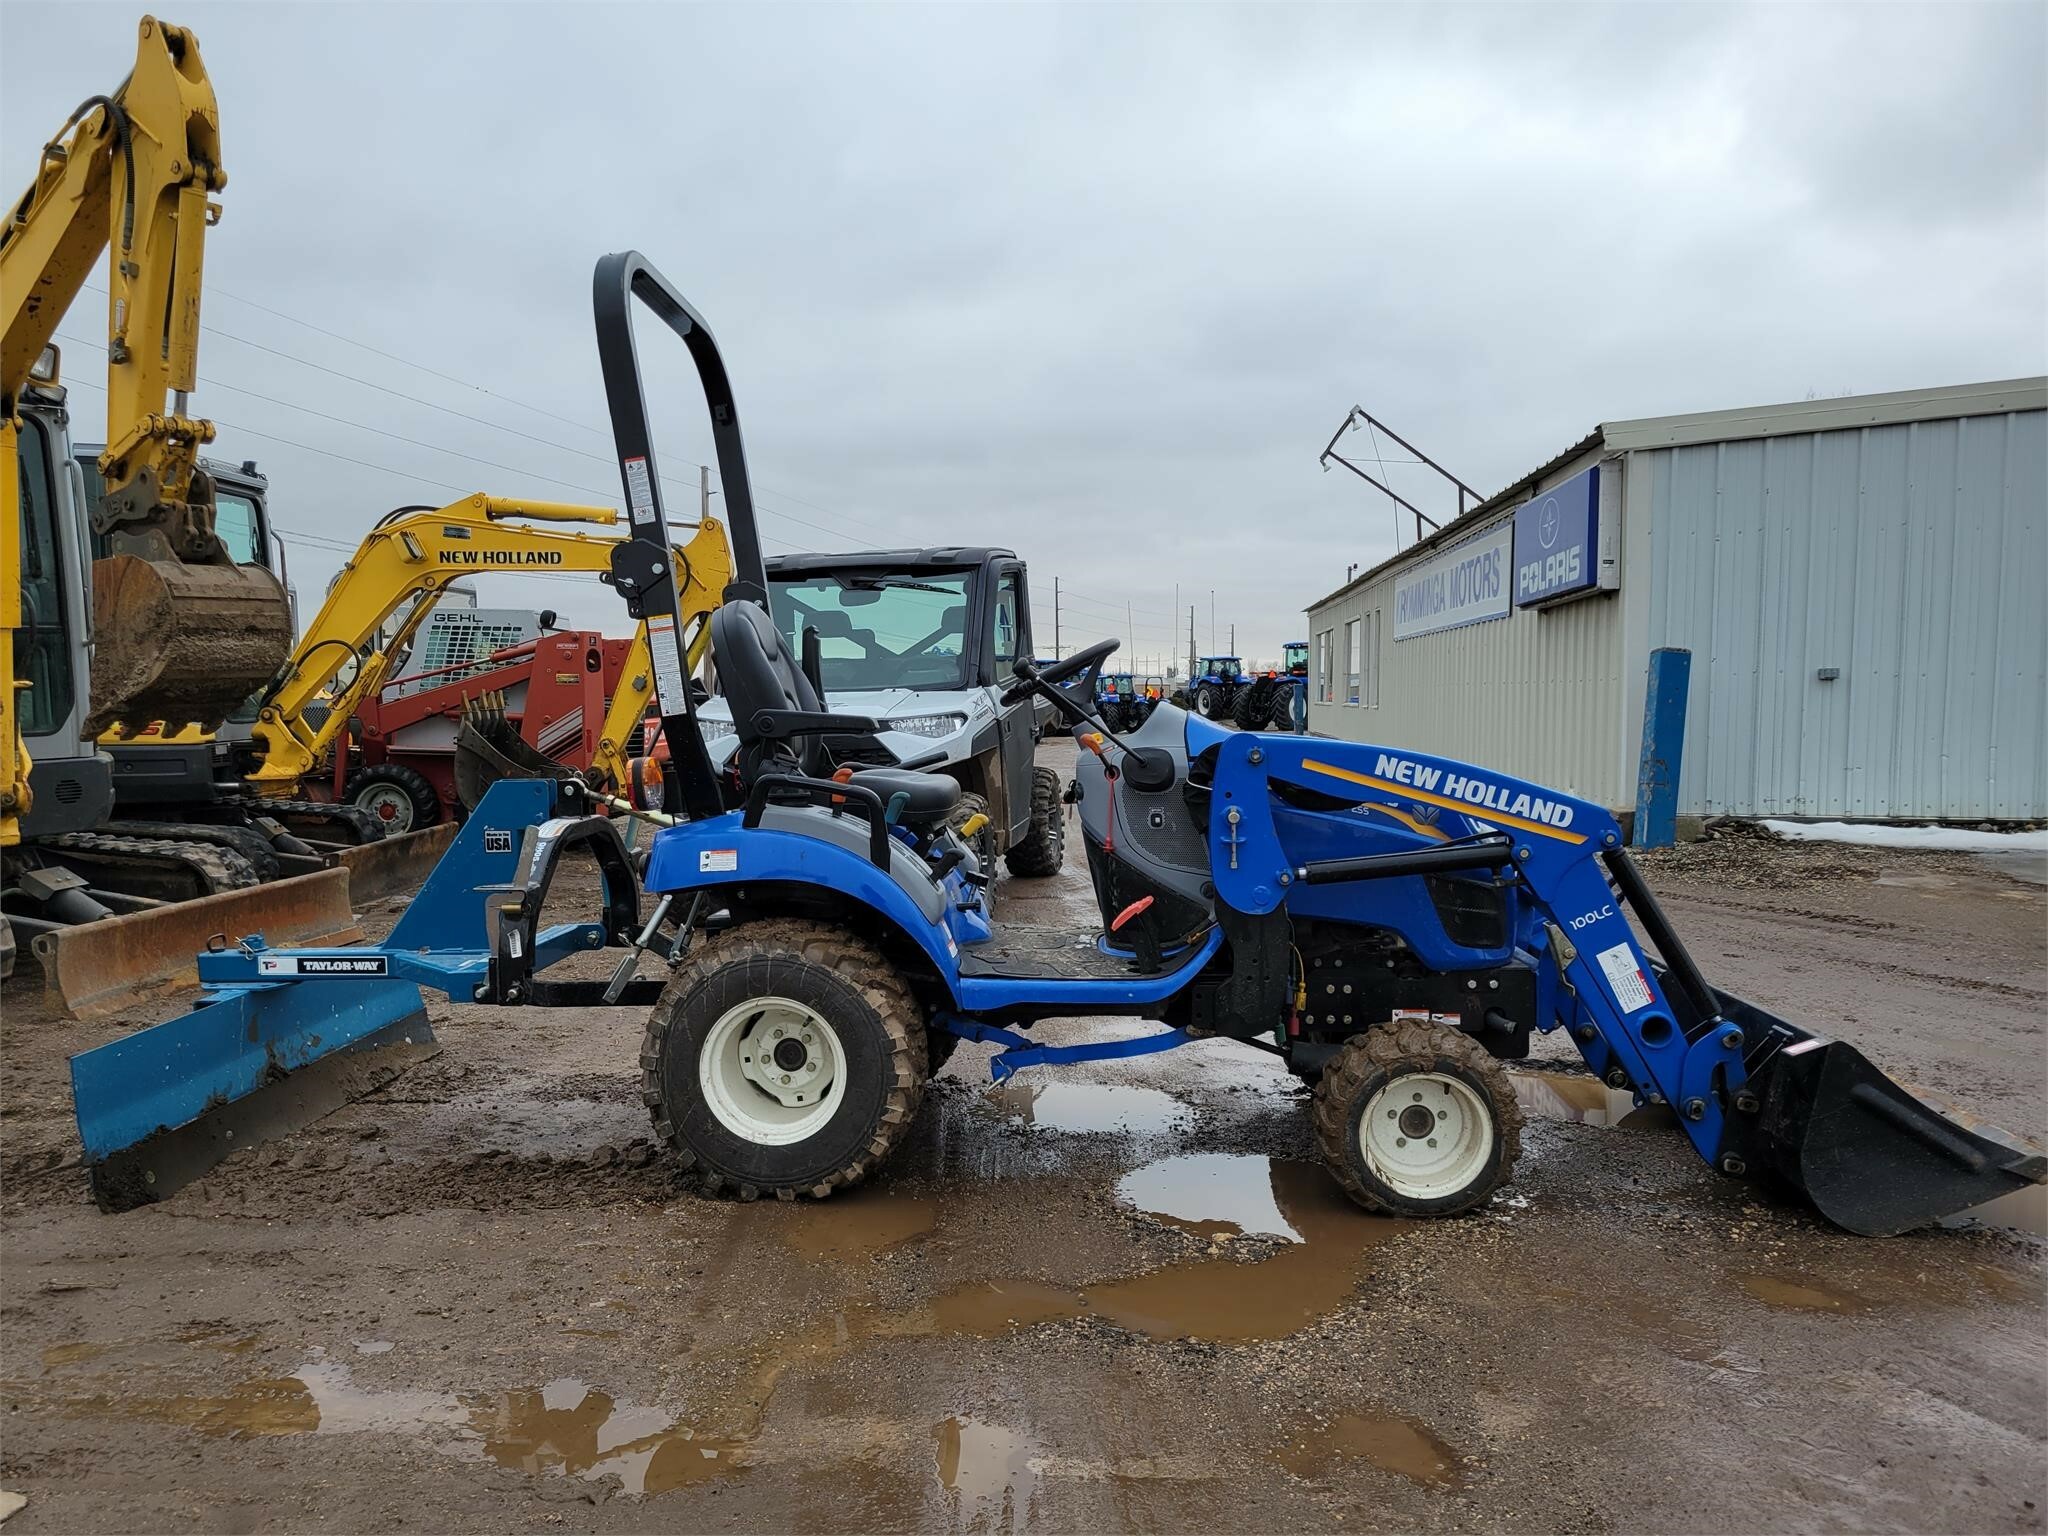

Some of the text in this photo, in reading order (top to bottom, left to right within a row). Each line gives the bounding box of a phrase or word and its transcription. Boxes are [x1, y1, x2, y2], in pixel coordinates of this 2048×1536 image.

[439, 551, 562, 565] NEW HOLLAND
[1450, 547, 1500, 610] MOTORS
[1520, 544, 1580, 597] POLARIS
[434, 613, 484, 623] GEHL
[1374, 754, 1574, 829] NEW HOLLAND
[487, 838, 510, 850] USA
[1569, 904, 1614, 931] 100LC
[303, 961, 379, 971] TAYLOR-WAY
